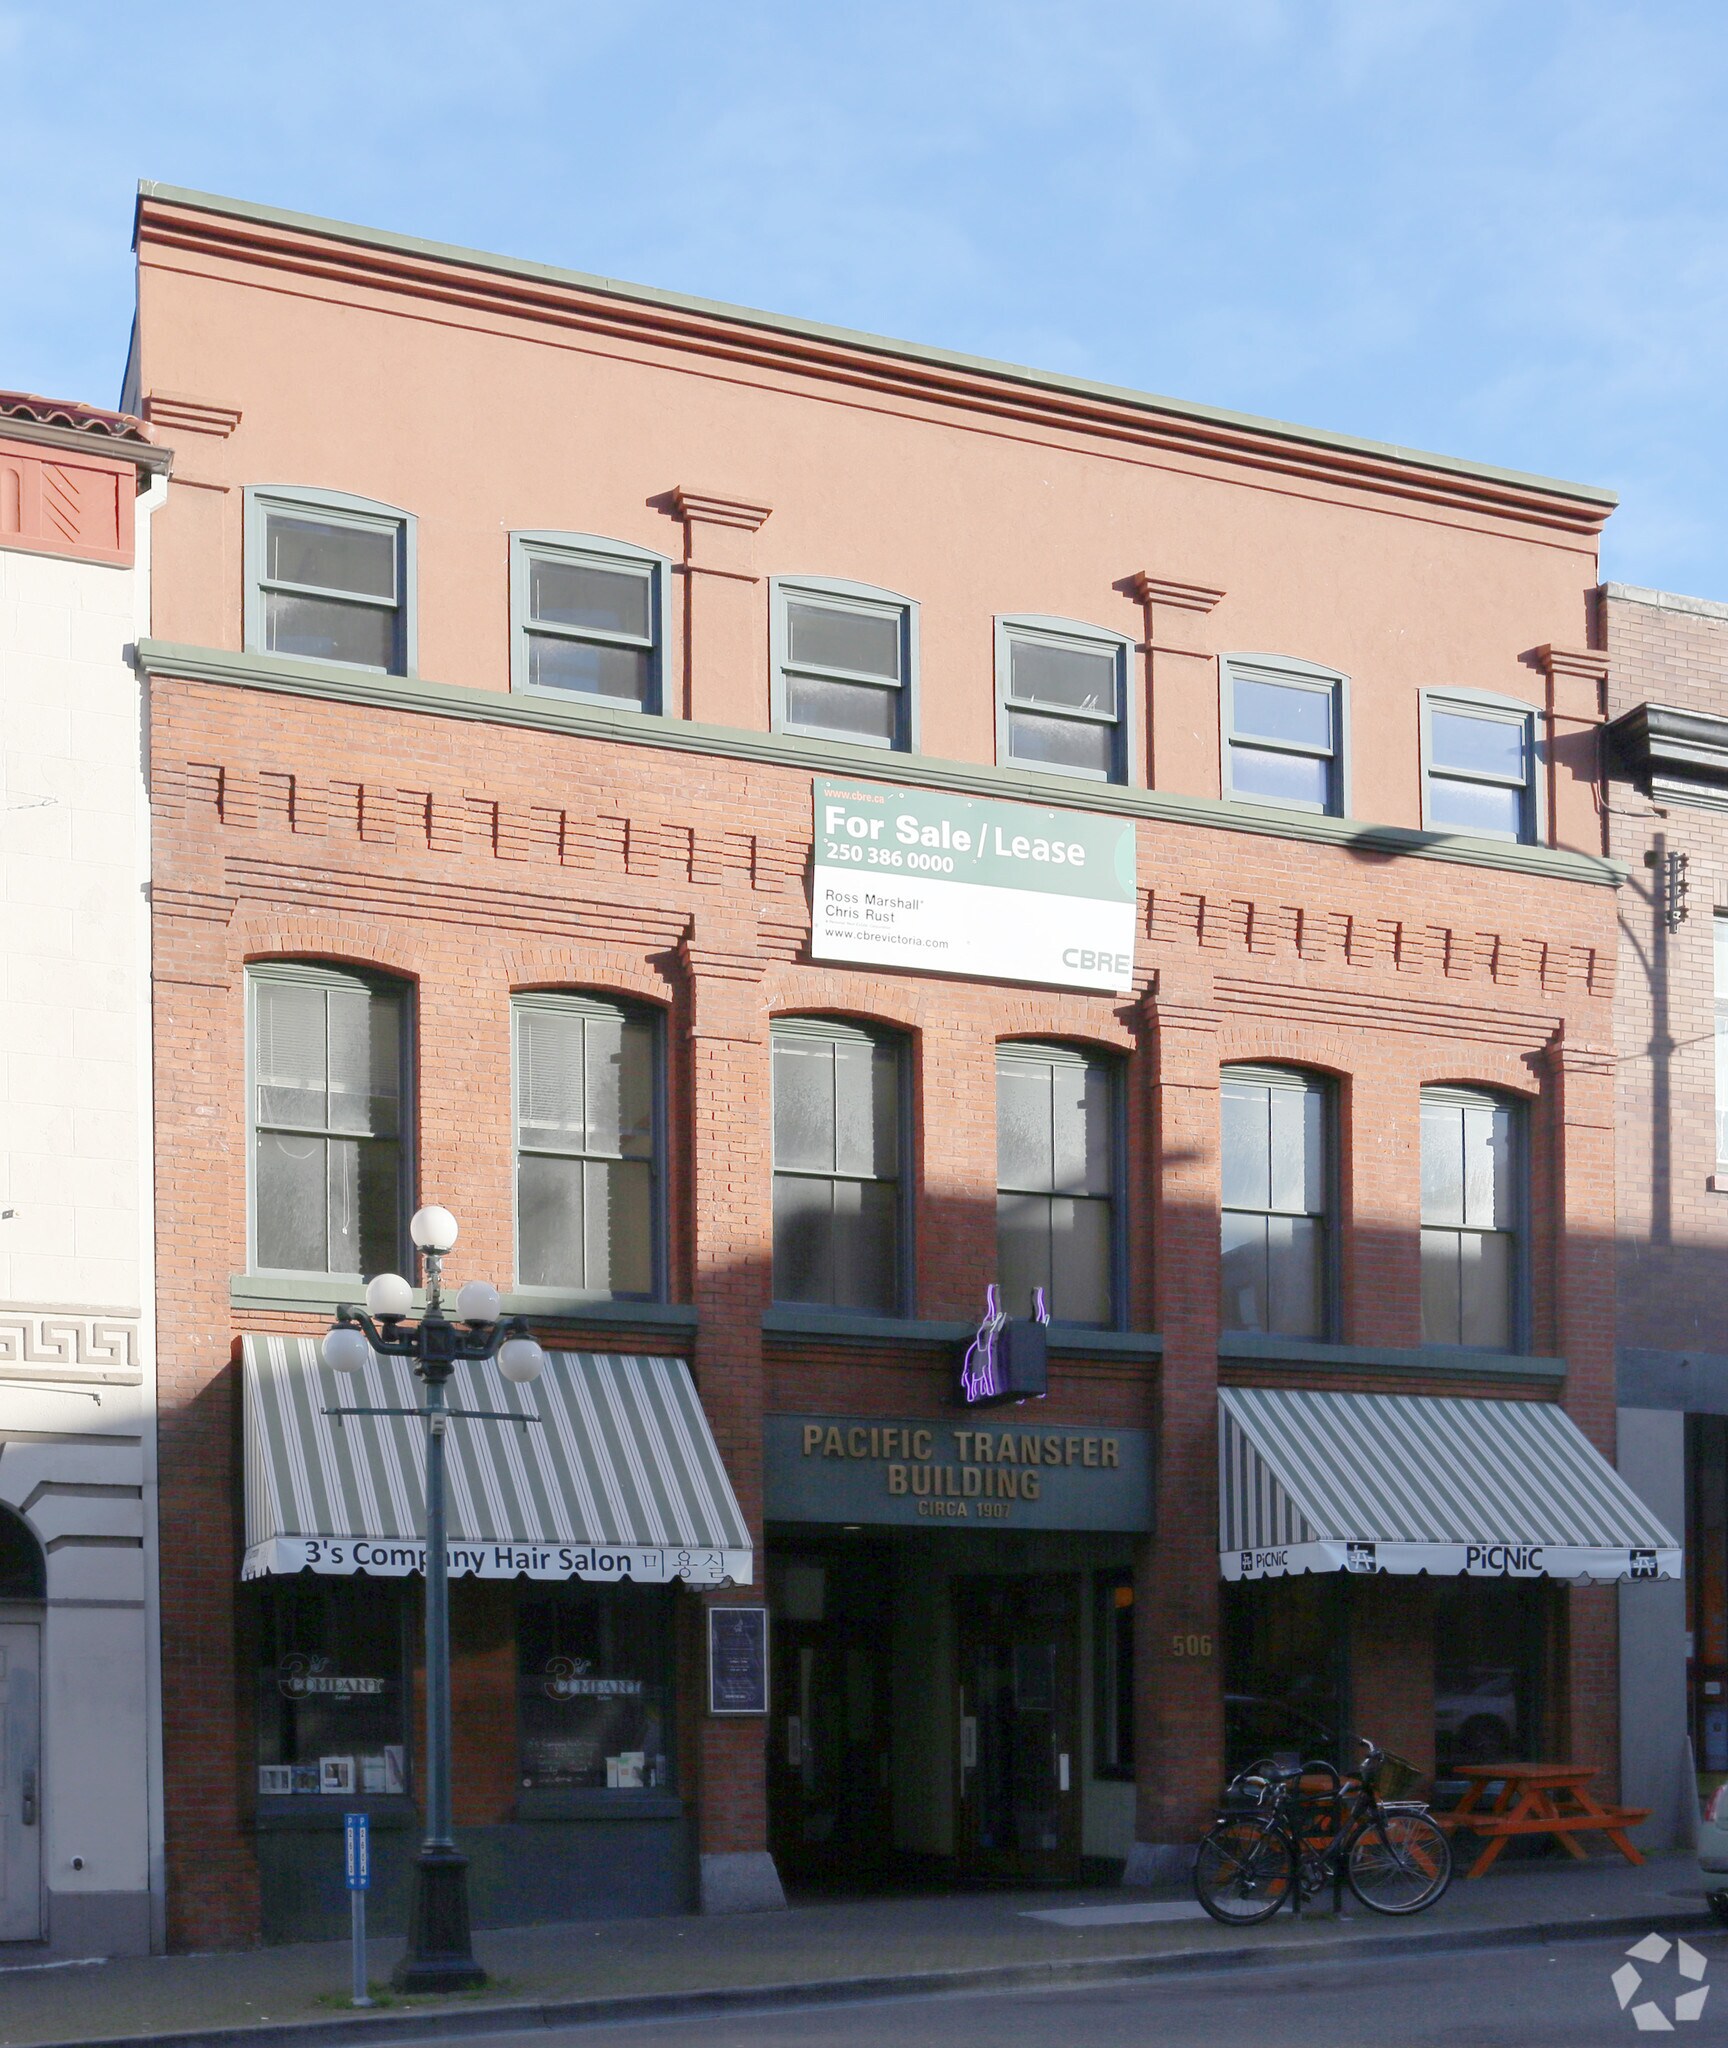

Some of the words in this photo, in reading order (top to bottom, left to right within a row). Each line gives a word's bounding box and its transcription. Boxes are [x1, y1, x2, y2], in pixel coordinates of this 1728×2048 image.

[824, 788, 885, 804] www.cbre.ca
[825, 805, 885, 840] For
[895, 814, 971, 852] Sale
[995, 826, 1085, 866] Lease
[826, 842, 863, 862] 250
[867, 847, 903, 867] 386
[907, 852, 954, 873] 0000
[825, 889, 859, 904] Ross
[825, 904, 859, 919] Chris
[865, 909, 895, 923] Rust
[825, 928, 949, 949] www.cbrevictoria.com
[1062, 948, 1130, 975] CBRE
[803, 1424, 932, 1460] PACIFIC
[953, 1431, 1119, 1468] TRANSFER
[888, 1464, 1041, 1499] BUILDING
[918, 1500, 968, 1517] CIRCA
[976, 1503, 1011, 1518] 1907
[304, 1540, 344, 1564] 3's
[494, 1547, 551, 1570] Hair
[558, 1548, 632, 1572] Salon
[641, 1549, 728, 1579] 미용실
[1173, 1635, 1212, 1657] 506
